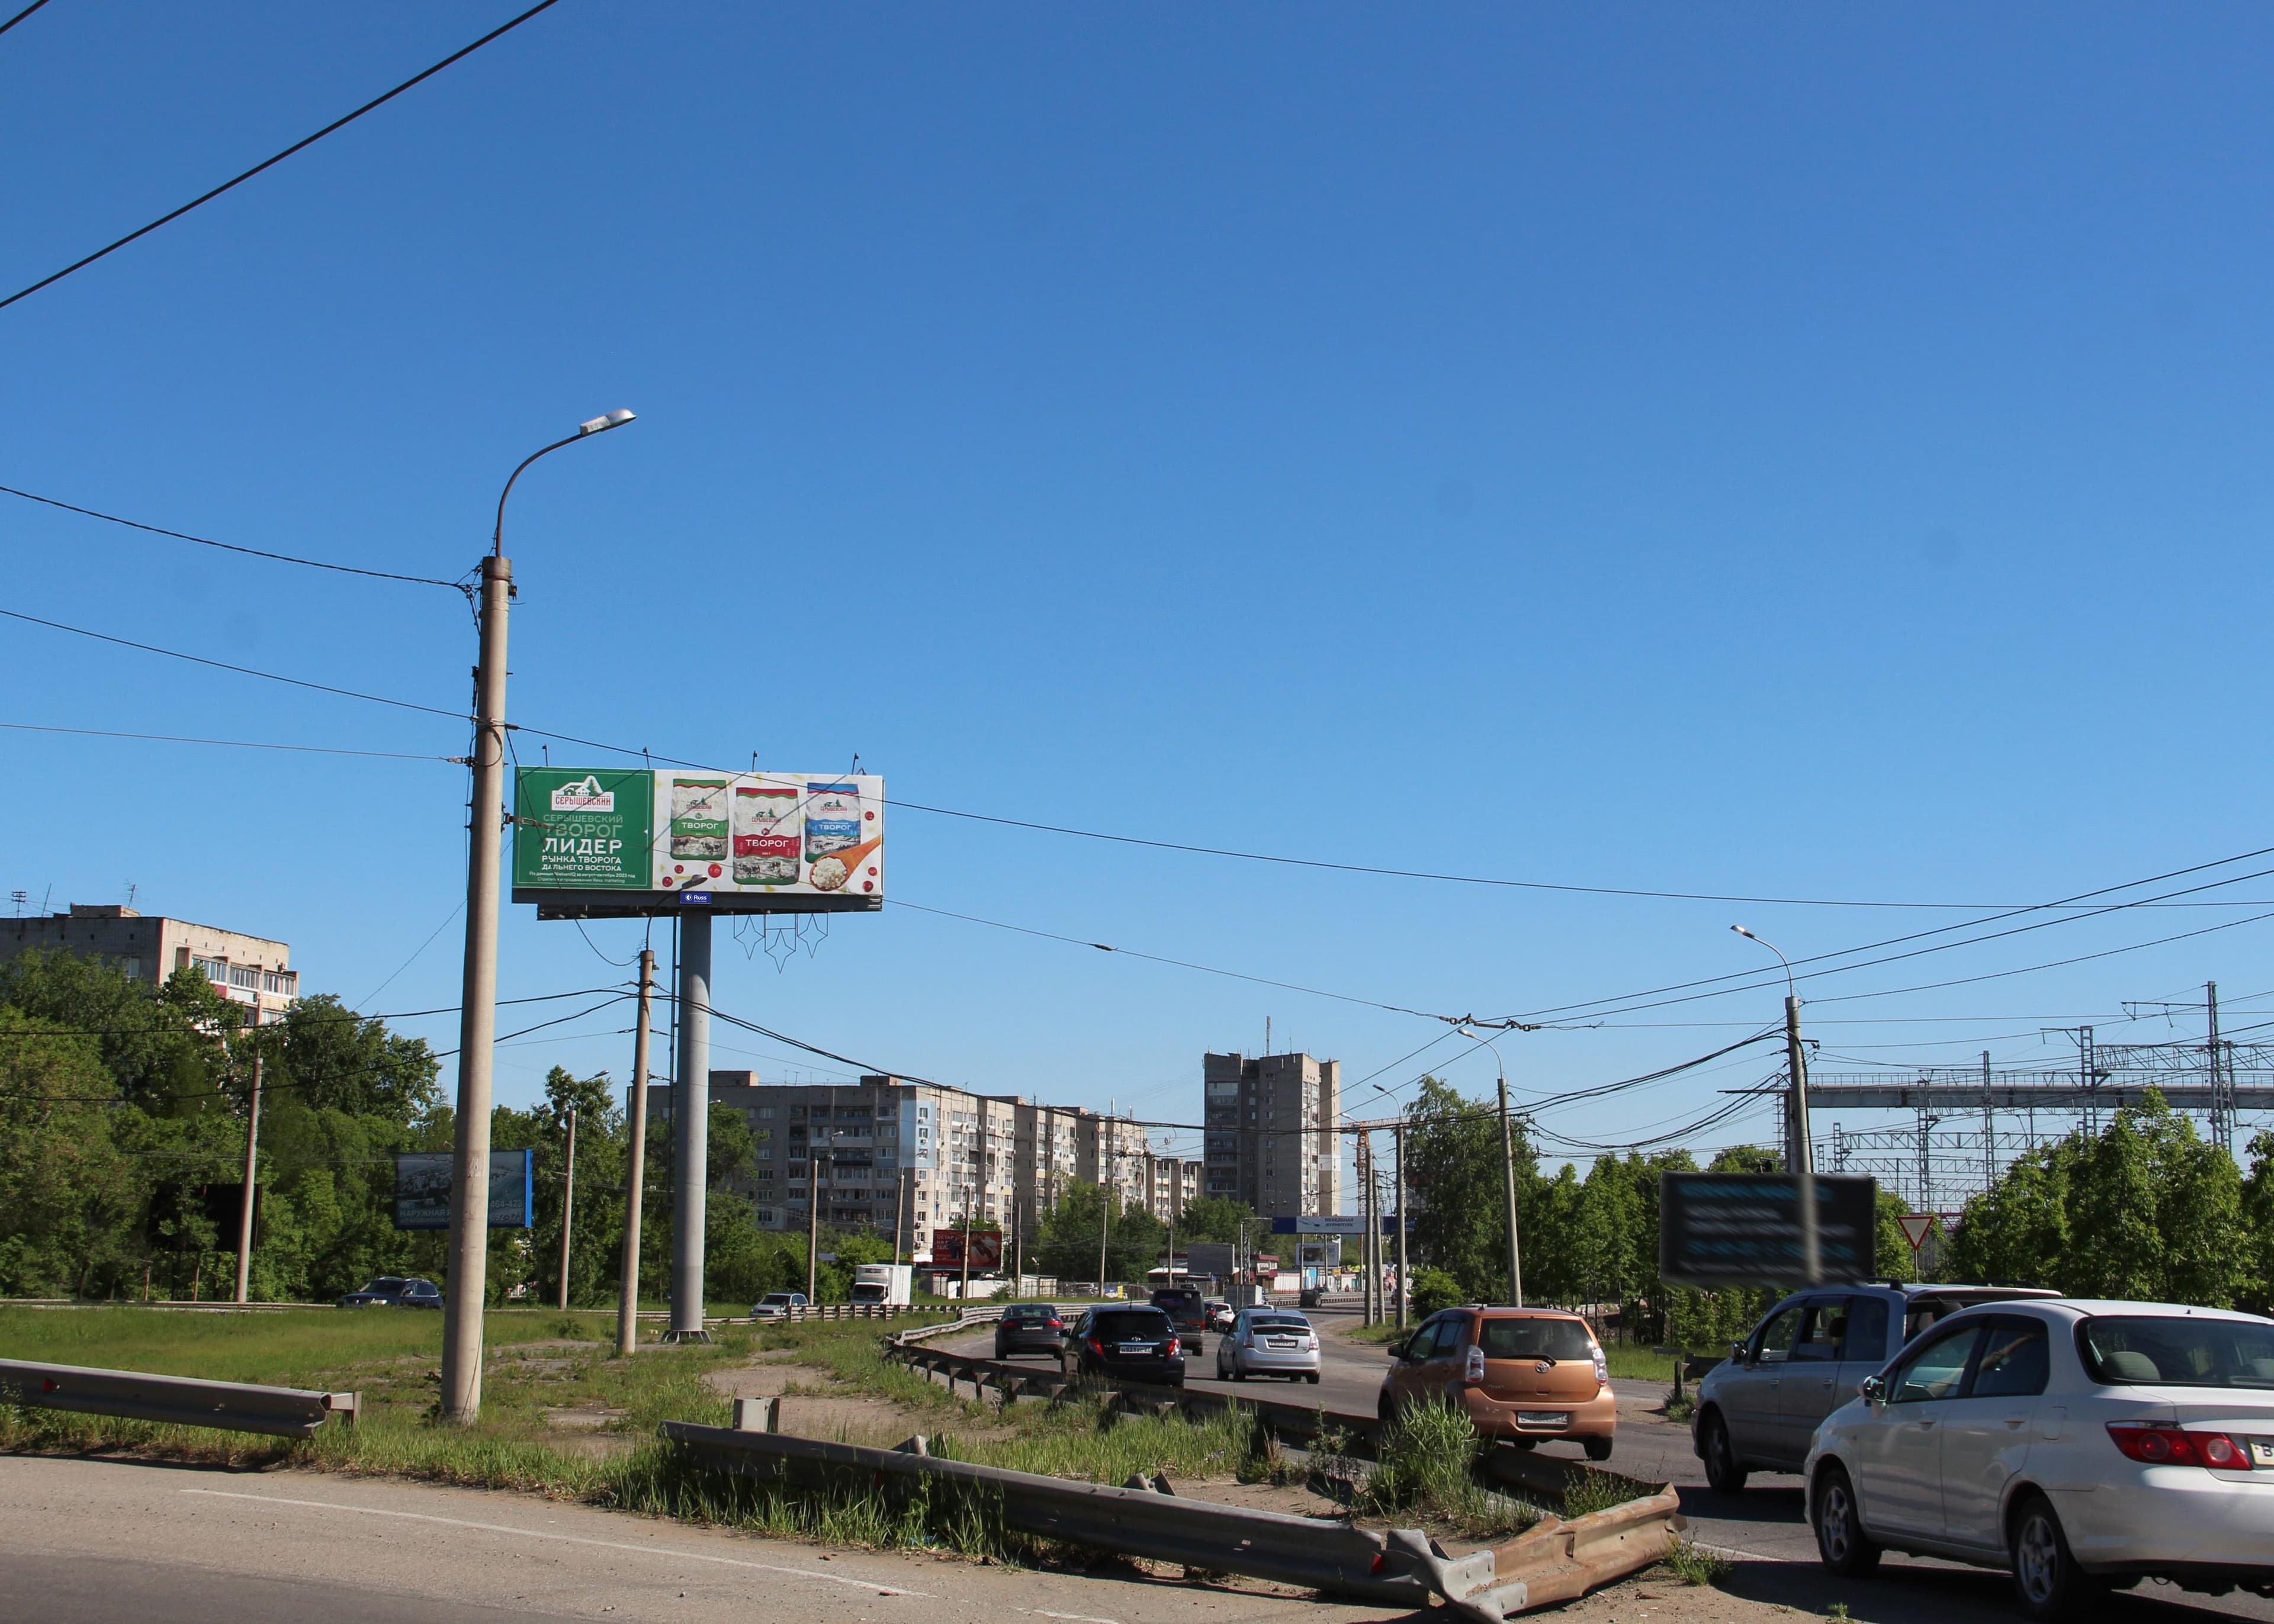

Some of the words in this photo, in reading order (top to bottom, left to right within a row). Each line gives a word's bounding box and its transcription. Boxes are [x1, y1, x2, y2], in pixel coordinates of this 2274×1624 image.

[555, 796, 611, 806] СЕРЫШЕВСКИЙ
[544, 814, 623, 823] СЕРЫШЕВСКИЙ
[544, 824, 623, 838] ТВОРОГ
[542, 838, 622, 856] ЛИДЕР
[578, 856, 622, 864] ТВОРОГА
[400, 1208, 446, 1217] НАРУЖНАЯ
